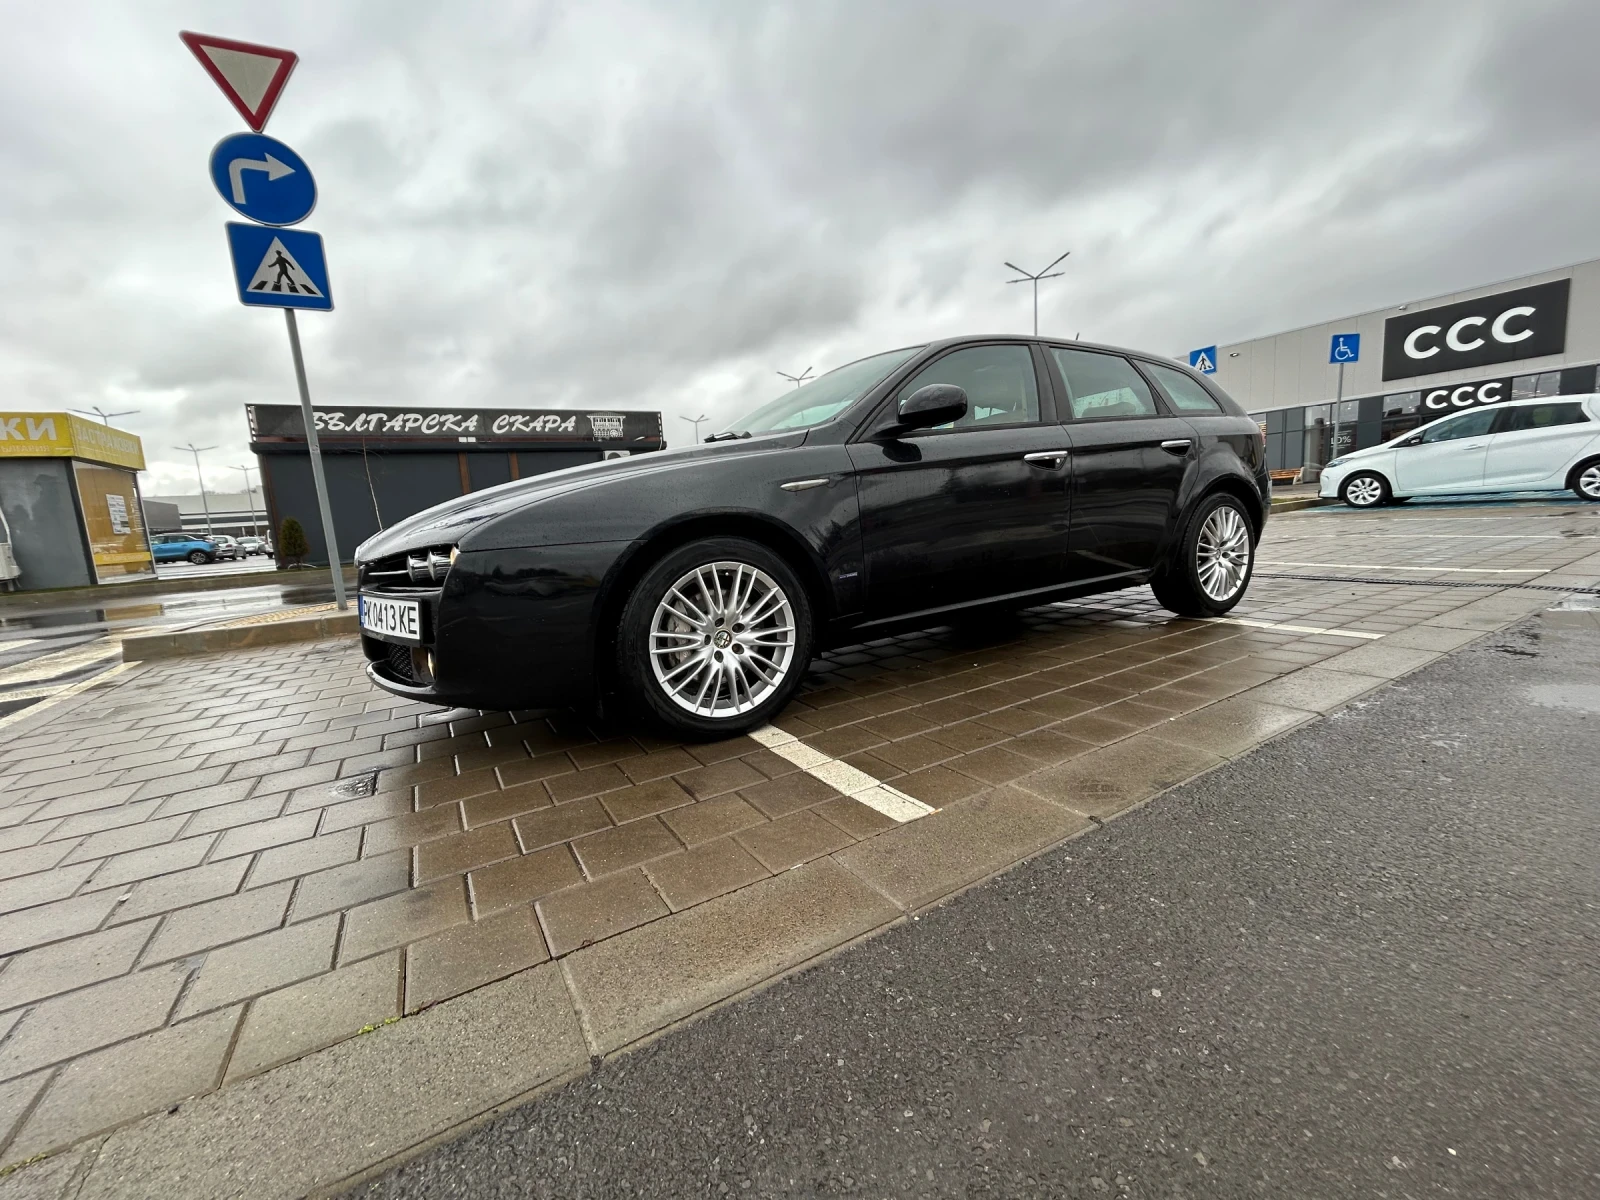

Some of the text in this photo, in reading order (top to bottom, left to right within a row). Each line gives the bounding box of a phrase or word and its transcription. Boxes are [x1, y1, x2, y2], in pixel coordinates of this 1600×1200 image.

[1403, 306, 1537, 360] CCC
[1425, 382, 1503, 409] CCC
[492, 414, 577, 434] СКАРА
[373, 601, 397, 632] 0413
[398, 604, 418, 635] KE
